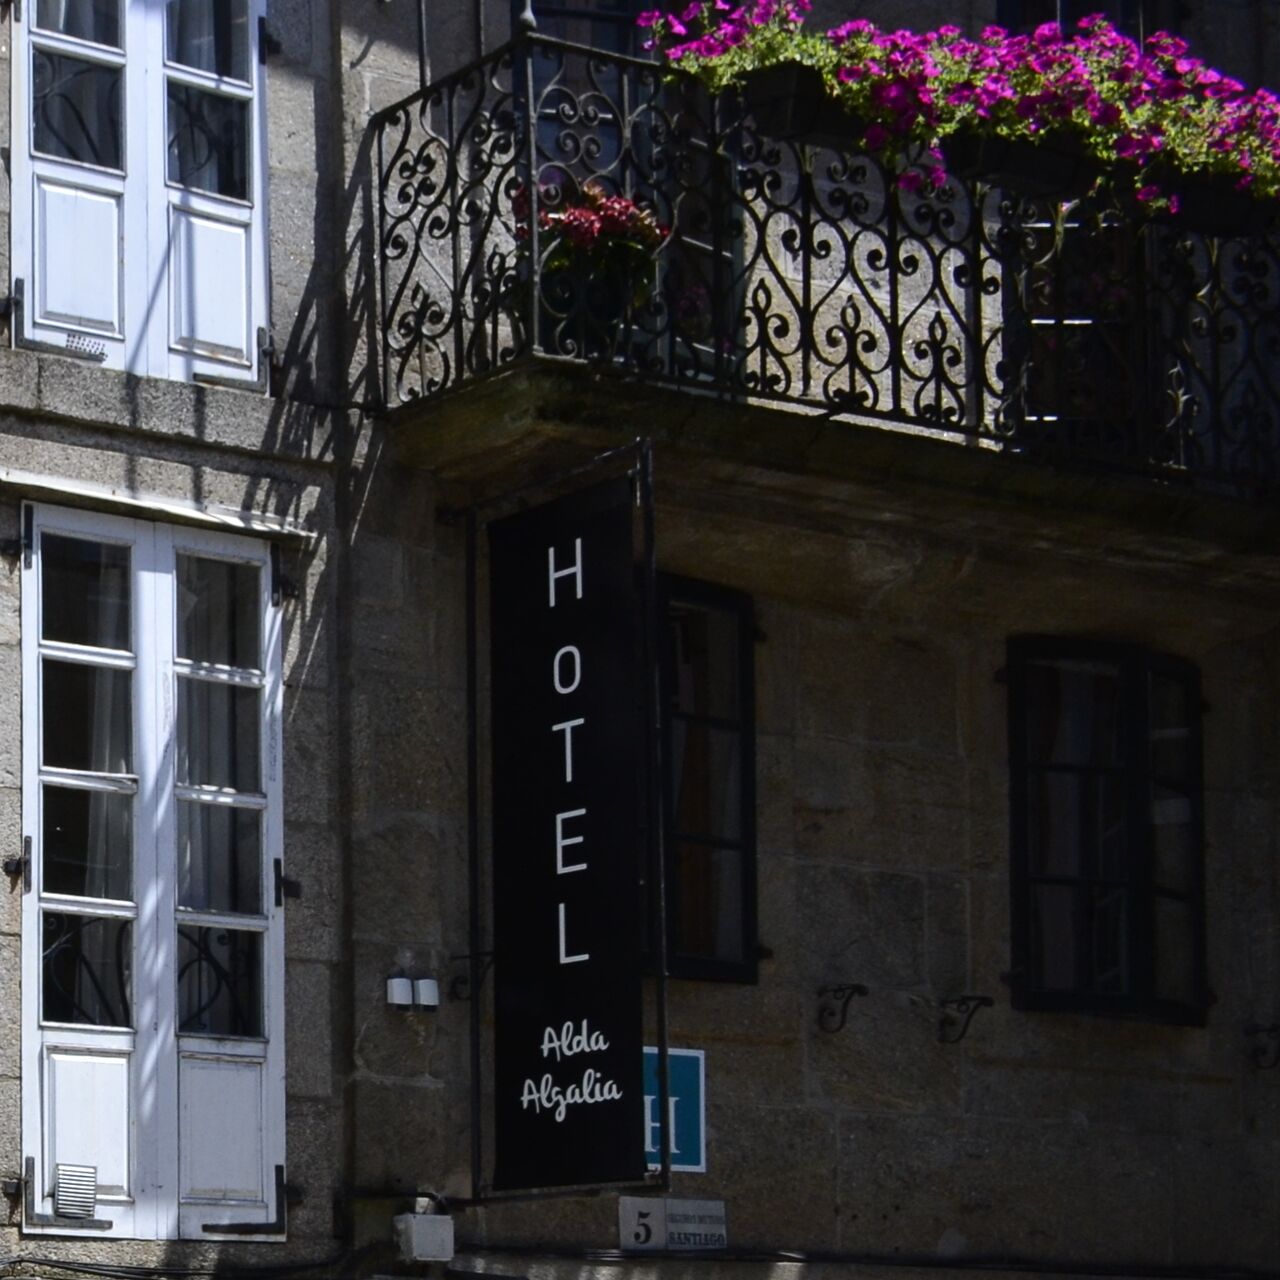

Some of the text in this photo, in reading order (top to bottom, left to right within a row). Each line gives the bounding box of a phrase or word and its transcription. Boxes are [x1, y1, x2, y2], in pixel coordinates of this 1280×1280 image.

[547, 536, 590, 965] HOTEL
[540, 1018, 610, 1062] Alda
[520, 1068, 623, 1122] Algalia
[643, 1095, 681, 1154] H
[633, 1210, 653, 1245] 5
